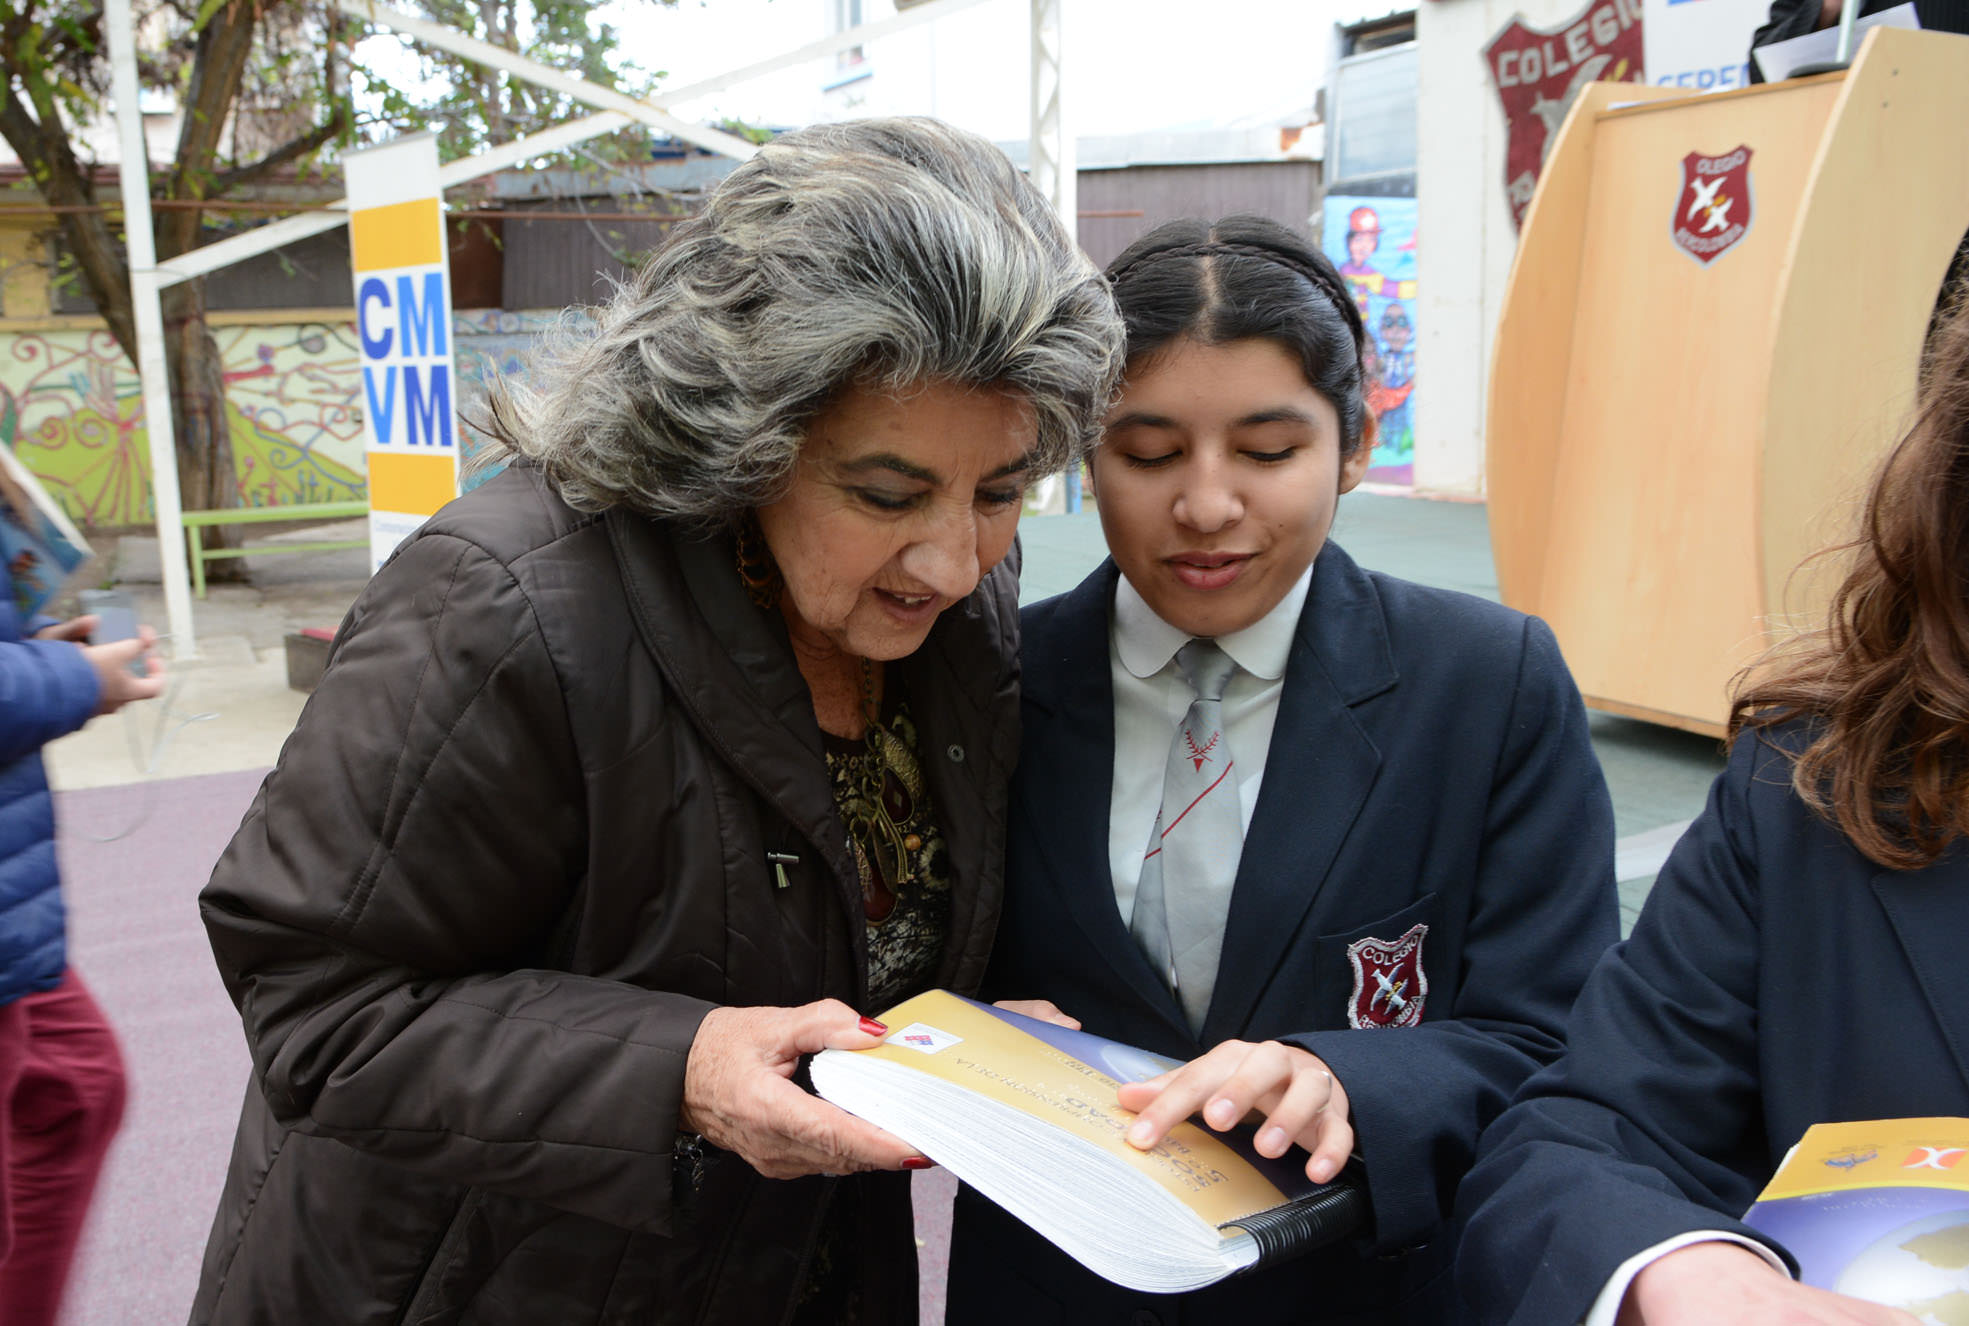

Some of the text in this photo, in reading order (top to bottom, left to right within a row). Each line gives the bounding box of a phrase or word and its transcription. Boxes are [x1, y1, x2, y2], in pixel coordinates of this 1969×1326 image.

[358, 272, 447, 361] CM
[363, 365, 453, 447] VM
[1362, 935, 1418, 966] COLEGIO
